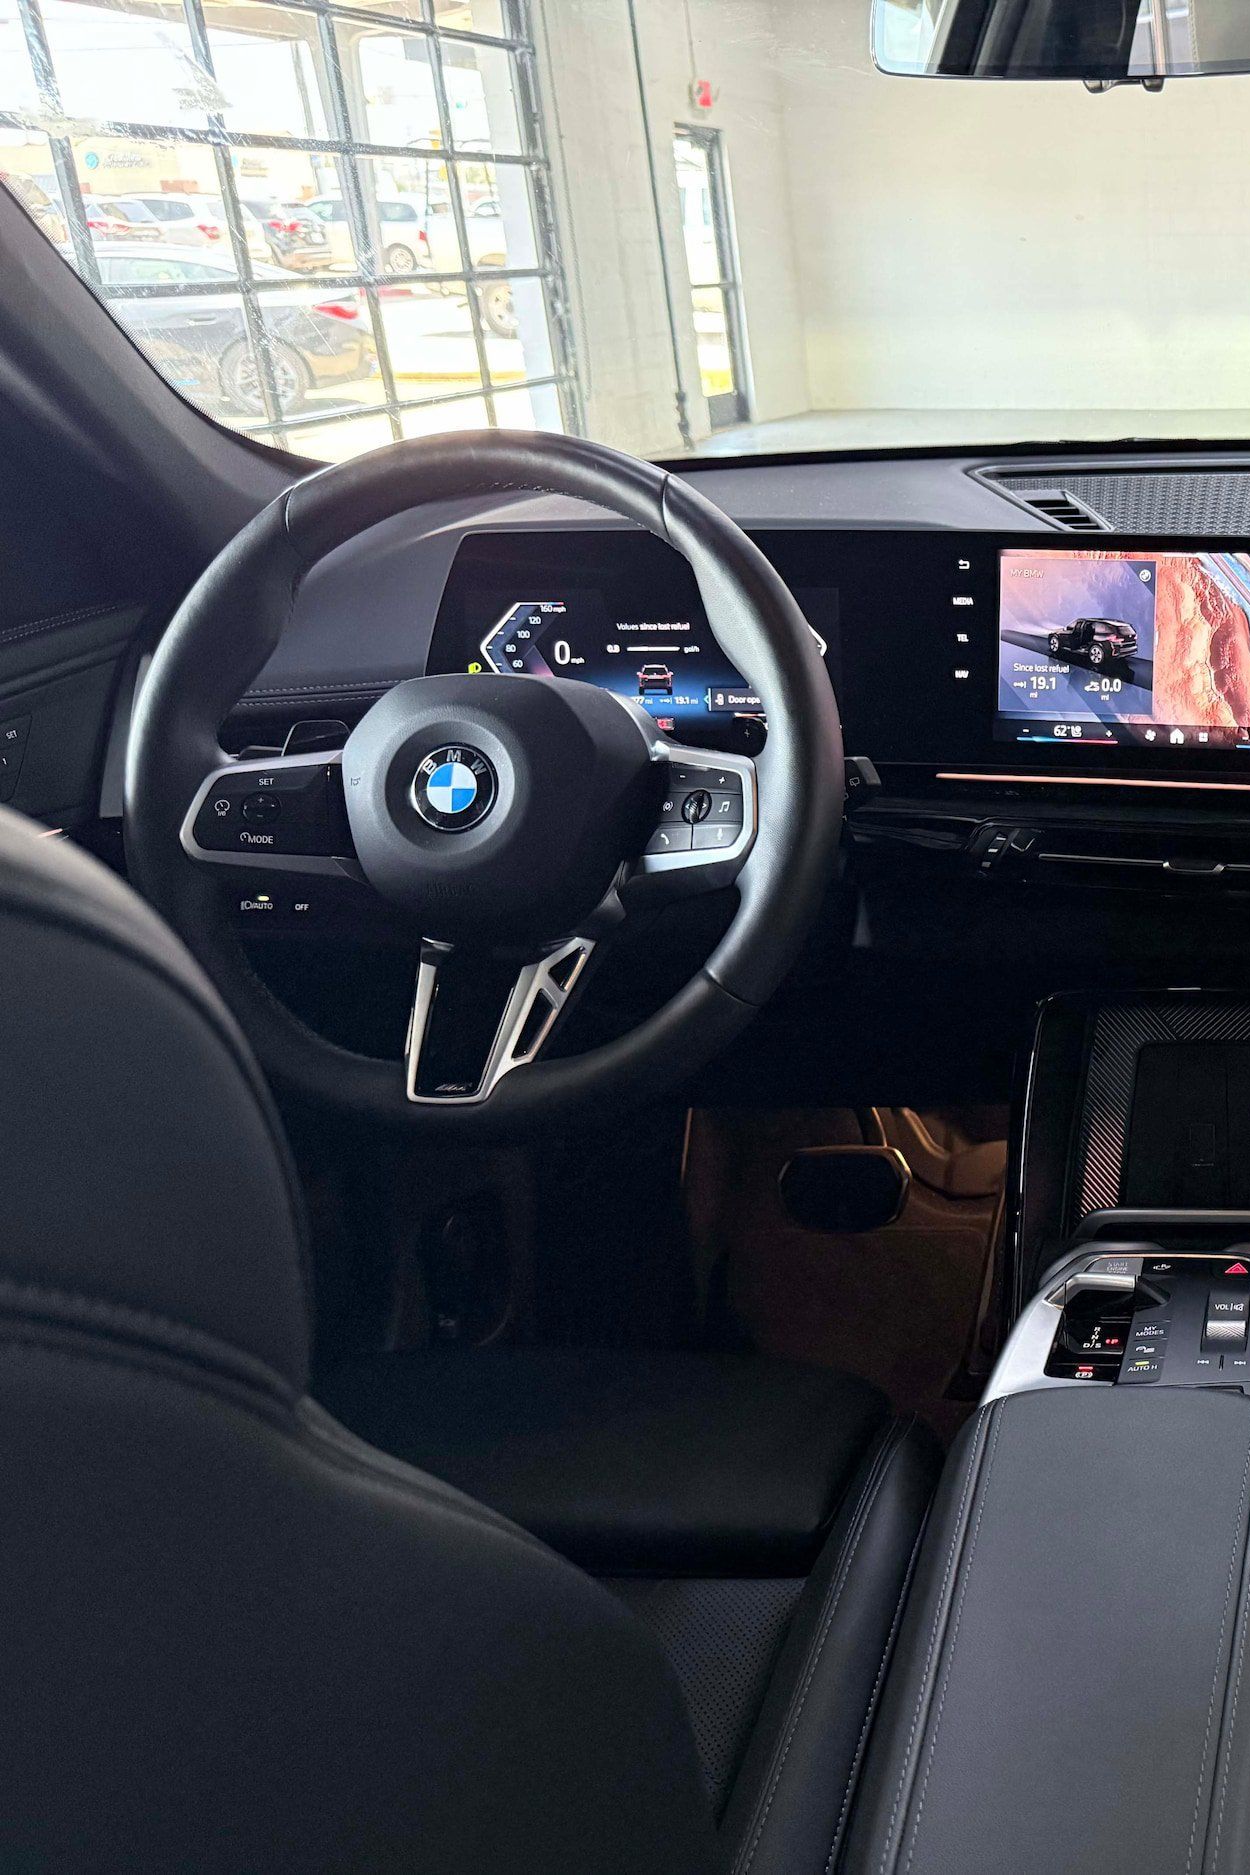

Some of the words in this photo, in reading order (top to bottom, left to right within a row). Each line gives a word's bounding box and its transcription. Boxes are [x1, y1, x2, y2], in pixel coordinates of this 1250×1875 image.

[1010, 569, 1023, 578] MY
[1024, 570, 1044, 578] BMW
[952, 597, 974, 606] MEDIA
[540, 605, 553, 613] 160
[529, 616, 542, 625] 120
[616, 623, 639, 631] Values
[639, 623, 658, 631] since
[657, 623, 670, 631] last
[670, 623, 691, 631] refuel
[517, 630, 531, 639] 100
[956, 633, 970, 643] TEL
[505, 644, 517, 653] 80
[554, 640, 571, 666] 0
[570, 657, 586, 665] mph
[512, 660, 524, 669] 60
[1013, 663, 1034, 673] Since
[1034, 664, 1048, 673] last
[1048, 664, 1070, 674] refuel
[954, 670, 969, 679] NAV
[1030, 676, 1057, 690] 19.1
[1101, 678, 1122, 692] 0.0
[728, 695, 746, 704] Door
[1029, 691, 1039, 699] mi
[1100, 693, 1110, 701] mi
[675, 696, 690, 705] 19.1
[421, 748, 488, 776] BMW
[258, 777, 275, 786] SET
[248, 835, 275, 845] MODE
[294, 903, 309, 911] OFF
[1214, 1303, 1229, 1311] VOL
[1135, 1329, 1165, 1337] MODES
